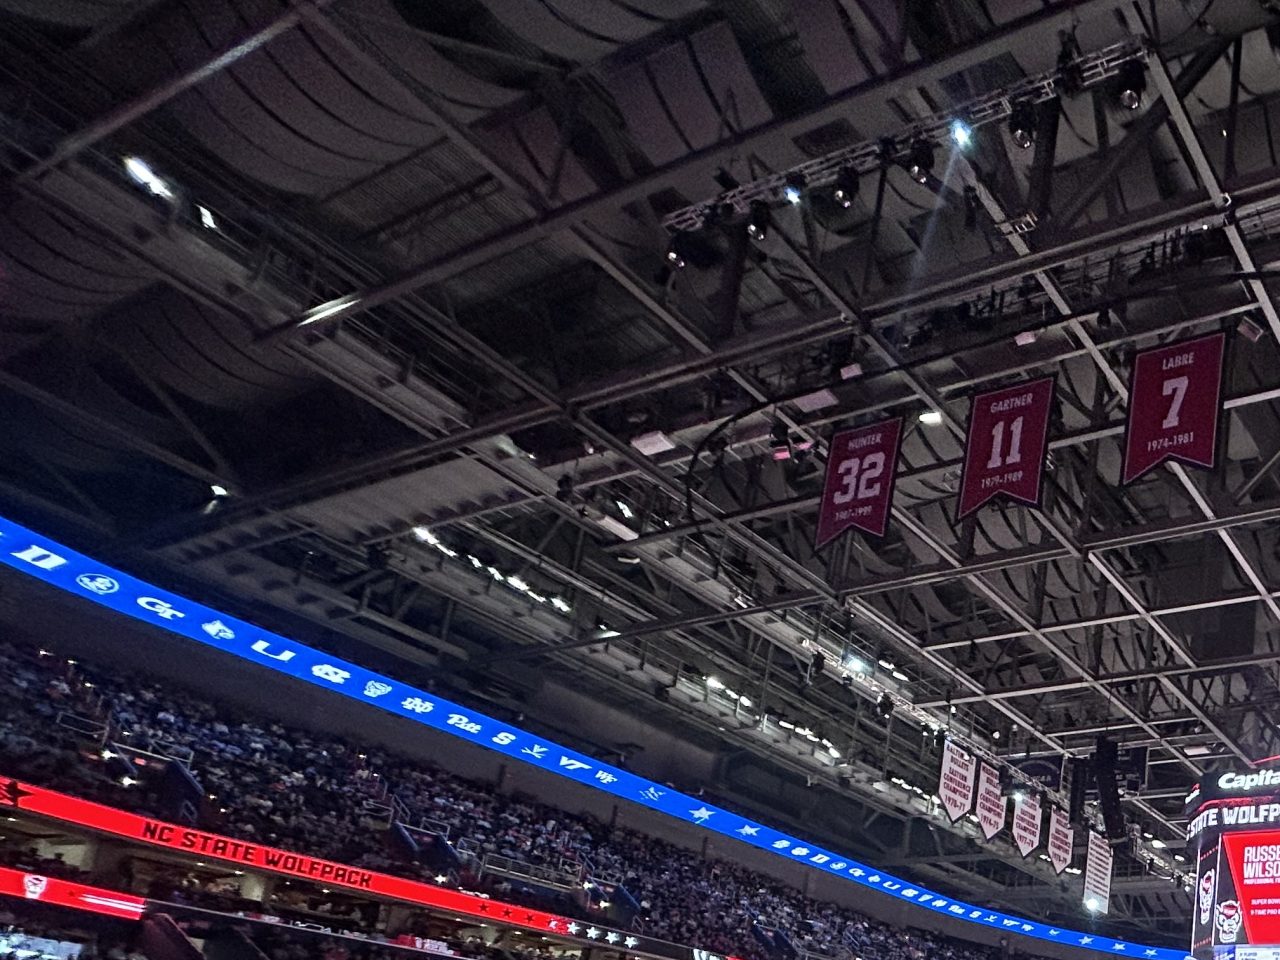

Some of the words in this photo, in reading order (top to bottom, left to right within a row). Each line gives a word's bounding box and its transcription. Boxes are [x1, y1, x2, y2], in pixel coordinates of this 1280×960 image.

[1162, 352, 1195, 370] LABRE
[990, 393, 1033, 413] GARTNER
[1162, 376, 1189, 429] 7
[848, 433, 882, 450] HUNTER
[987, 416, 1024, 468] 11
[1147, 432, 1194, 452] 1974-1981
[833, 451, 886, 505] 32
[143, 823, 174, 844] NC
[181, 832, 255, 864] STATE
[264, 850, 373, 888] WOLFPACK
